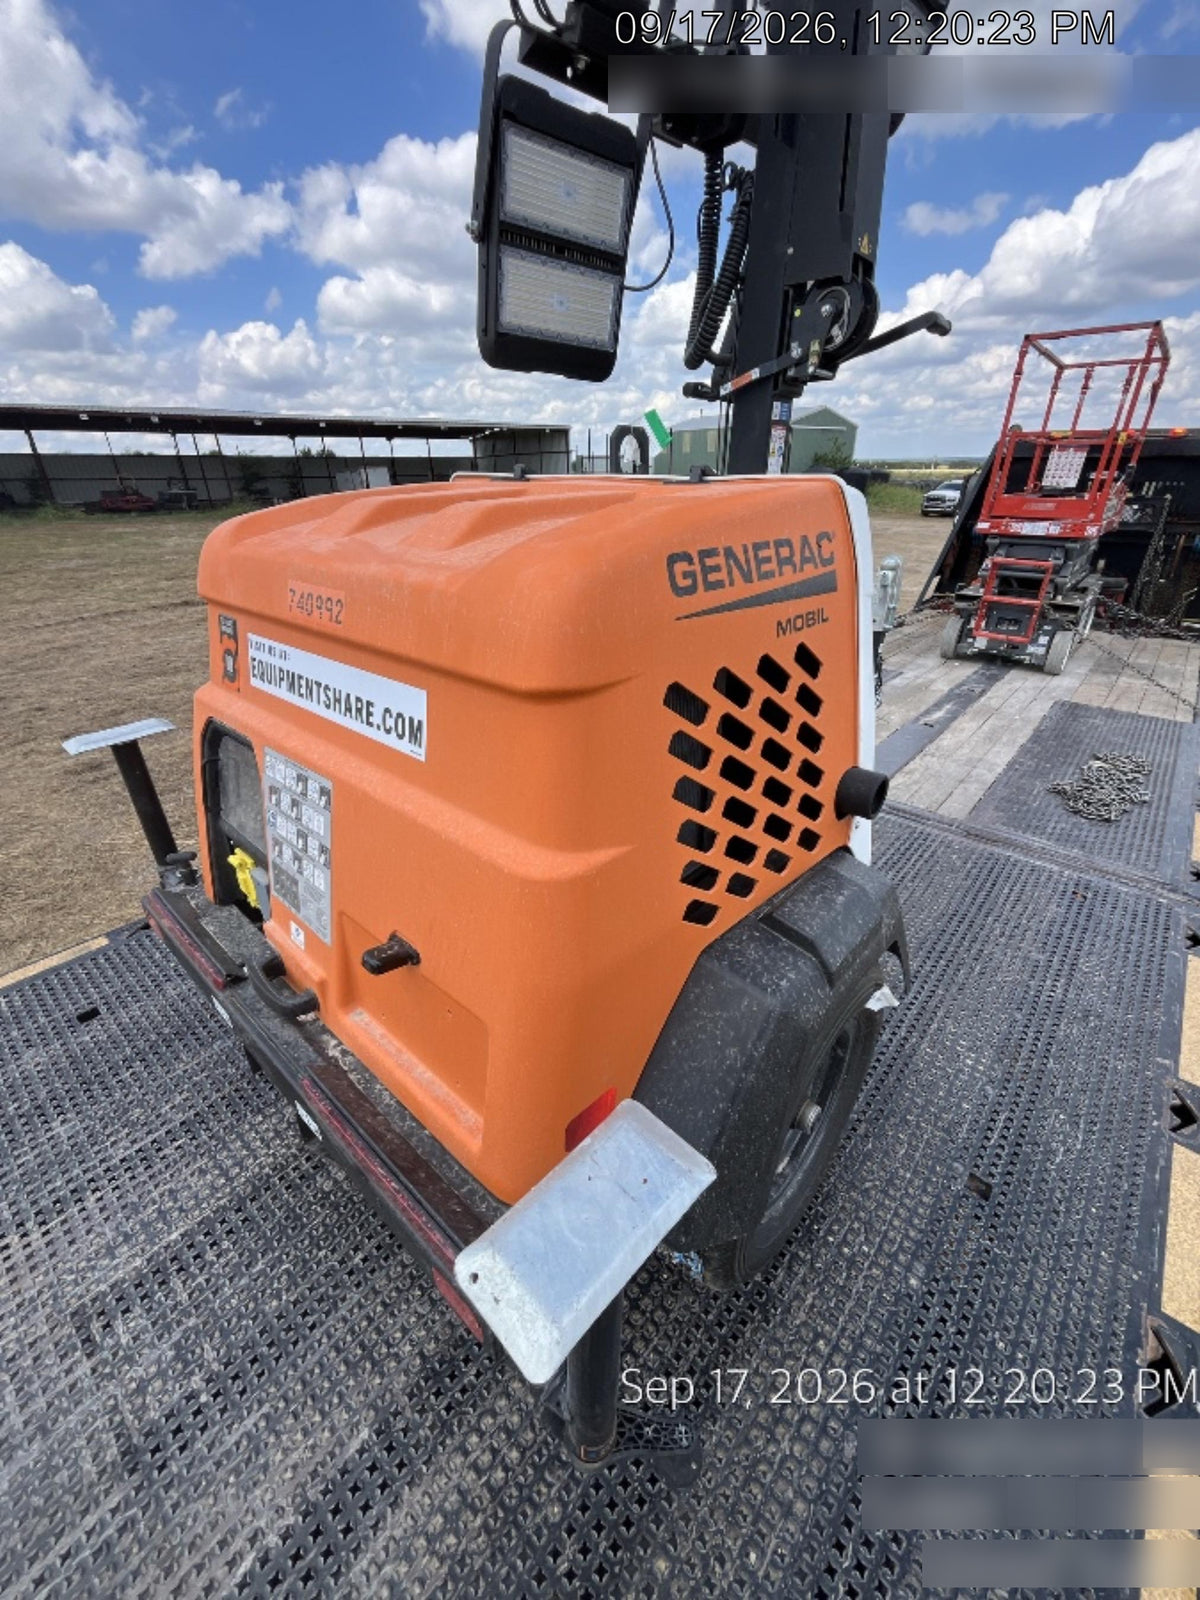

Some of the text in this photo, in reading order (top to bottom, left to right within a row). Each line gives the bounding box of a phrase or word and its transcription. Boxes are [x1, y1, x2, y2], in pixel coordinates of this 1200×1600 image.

[666, 531, 835, 597] GENERAC
[289, 588, 344, 625] 740992
[776, 608, 829, 638] MOBIL
[250, 656, 423, 749] EQUIPMENTSHARE.COM
